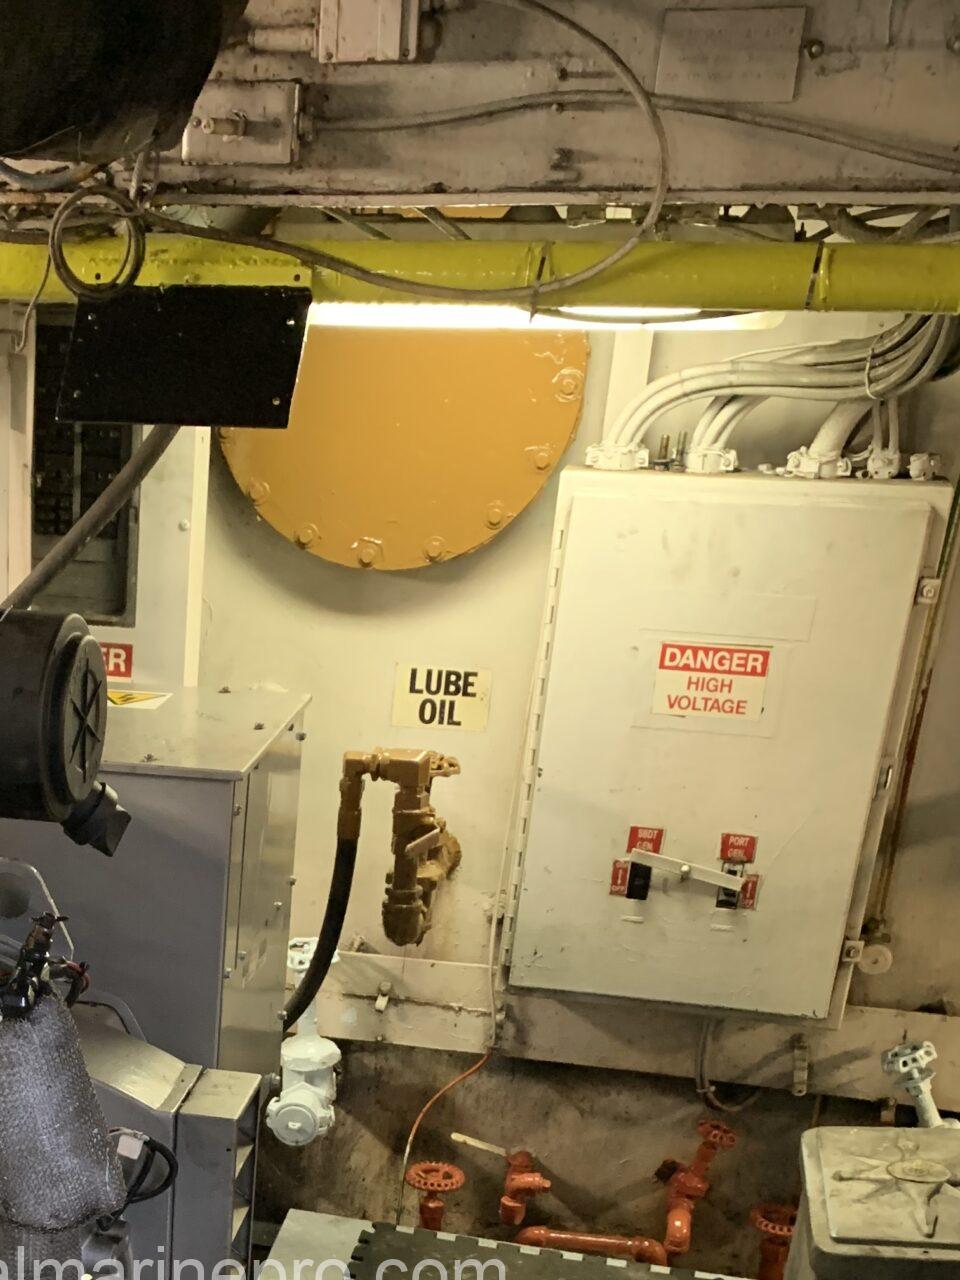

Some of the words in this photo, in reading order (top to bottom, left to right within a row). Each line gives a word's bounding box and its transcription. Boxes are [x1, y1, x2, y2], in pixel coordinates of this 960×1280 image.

[663, 647, 764, 673] DANGER
[409, 667, 478, 698] LUBE
[686, 676, 733, 694] HIGH
[418, 698, 462, 726] OIL
[667, 694, 748, 715] VOLTAGE
[728, 835, 750, 847] PORT
